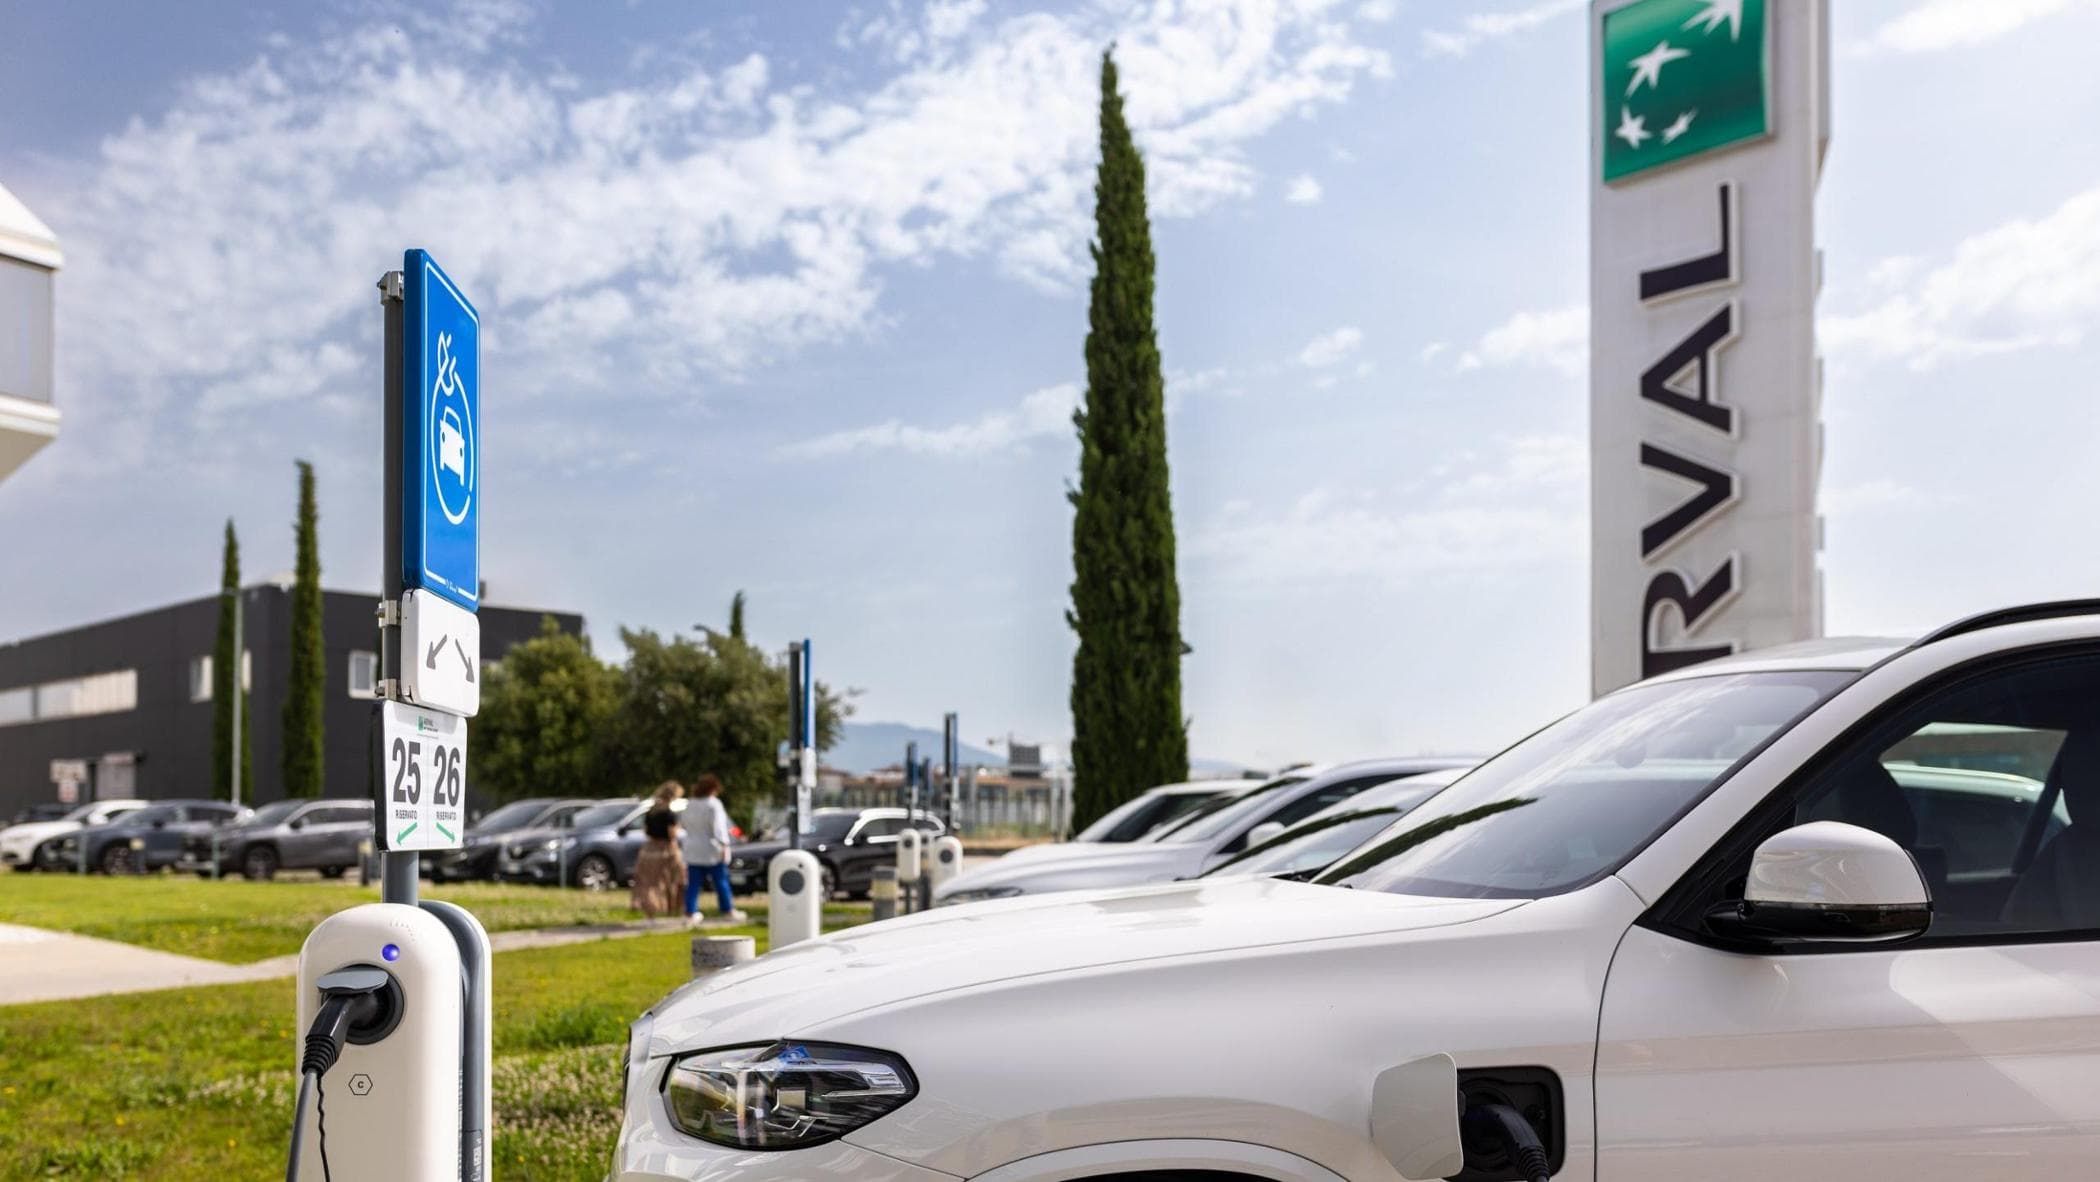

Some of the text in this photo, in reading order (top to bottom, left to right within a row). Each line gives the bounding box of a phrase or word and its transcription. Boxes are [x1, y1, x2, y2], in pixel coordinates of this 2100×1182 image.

[1640, 183, 1735, 680] RVAL
[392, 737, 421, 805] 25
[433, 745, 460, 807] 26
